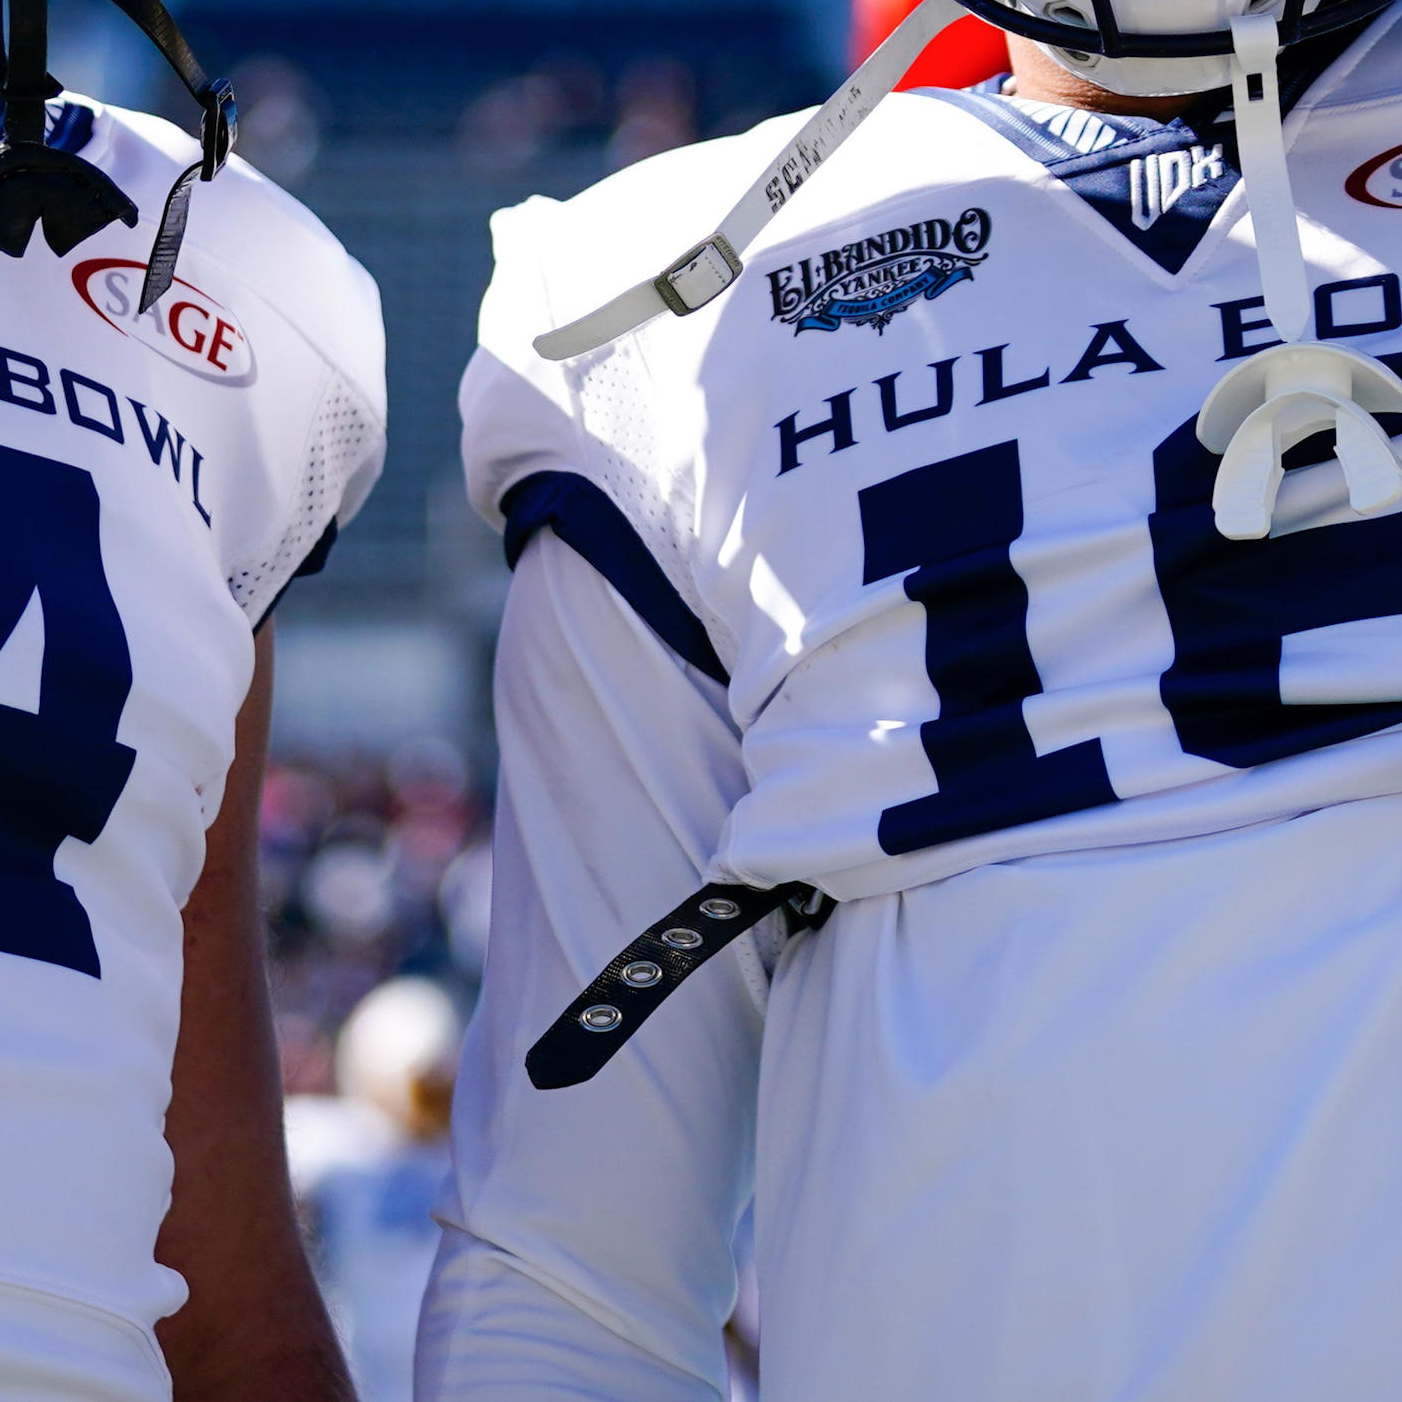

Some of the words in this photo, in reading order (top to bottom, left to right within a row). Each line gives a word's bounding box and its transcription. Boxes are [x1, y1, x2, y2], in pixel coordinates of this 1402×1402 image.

[837, 301, 878, 316] TEQUILA
[880, 277, 932, 307] COMPANY
[838, 256, 923, 297] YANKEE
[104, 271, 237, 372] SAGE
[773, 319, 1166, 477] HULA
